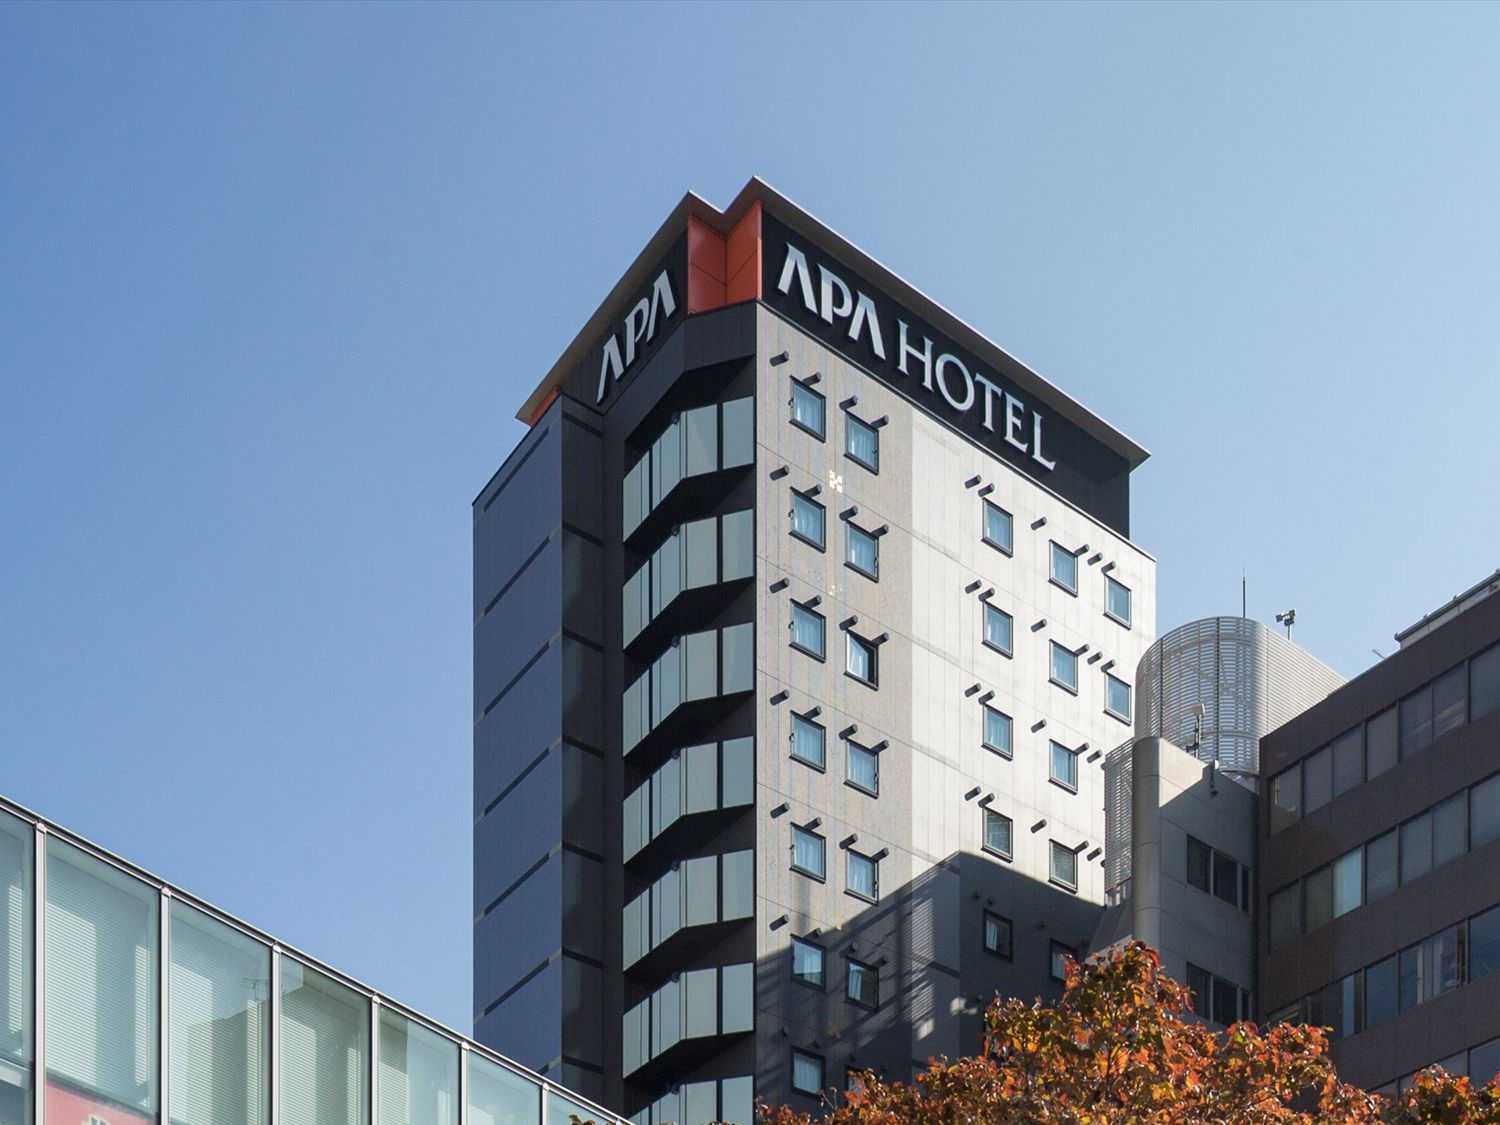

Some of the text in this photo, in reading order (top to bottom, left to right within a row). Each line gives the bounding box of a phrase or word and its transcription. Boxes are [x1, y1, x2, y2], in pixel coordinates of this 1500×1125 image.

[596, 268, 677, 404] APA
[778, 241, 1057, 471] APA HOTEL
